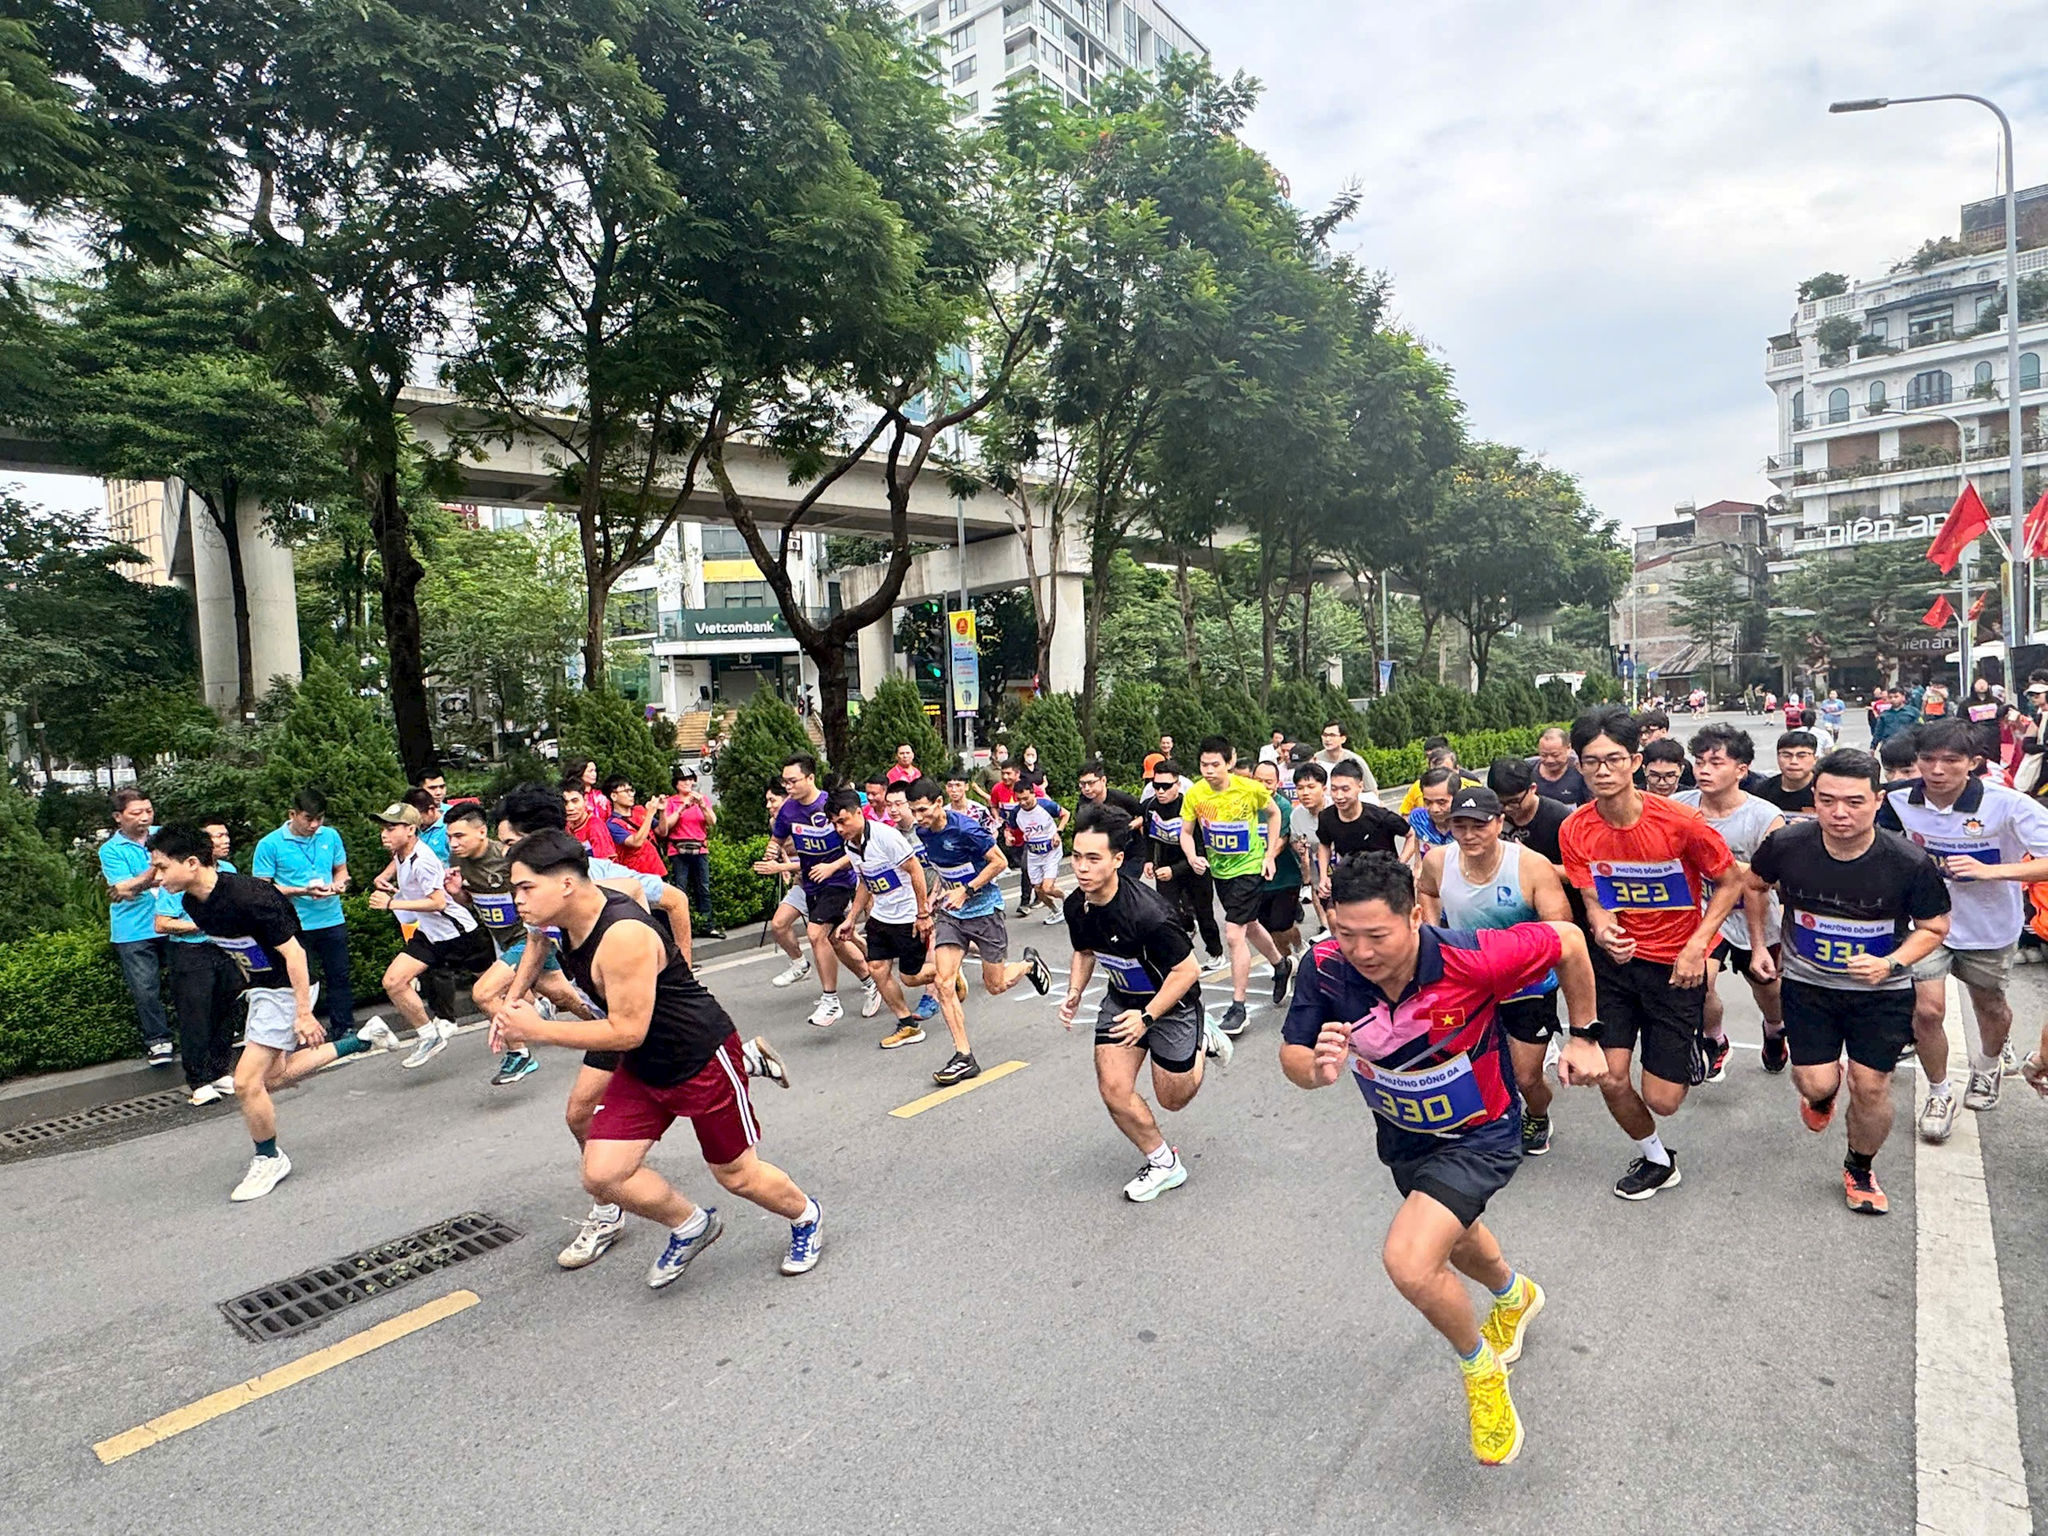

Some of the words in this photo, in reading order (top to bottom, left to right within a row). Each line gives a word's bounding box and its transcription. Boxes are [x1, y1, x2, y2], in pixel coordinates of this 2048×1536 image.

[695, 620, 775, 634] Vietcombank
[1931, 637, 1953, 649] an
[803, 838, 828, 850] 341
[1208, 832, 1238, 849] 309
[1612, 881, 1669, 902] 323
[1375, 1088, 1453, 1123] 330
